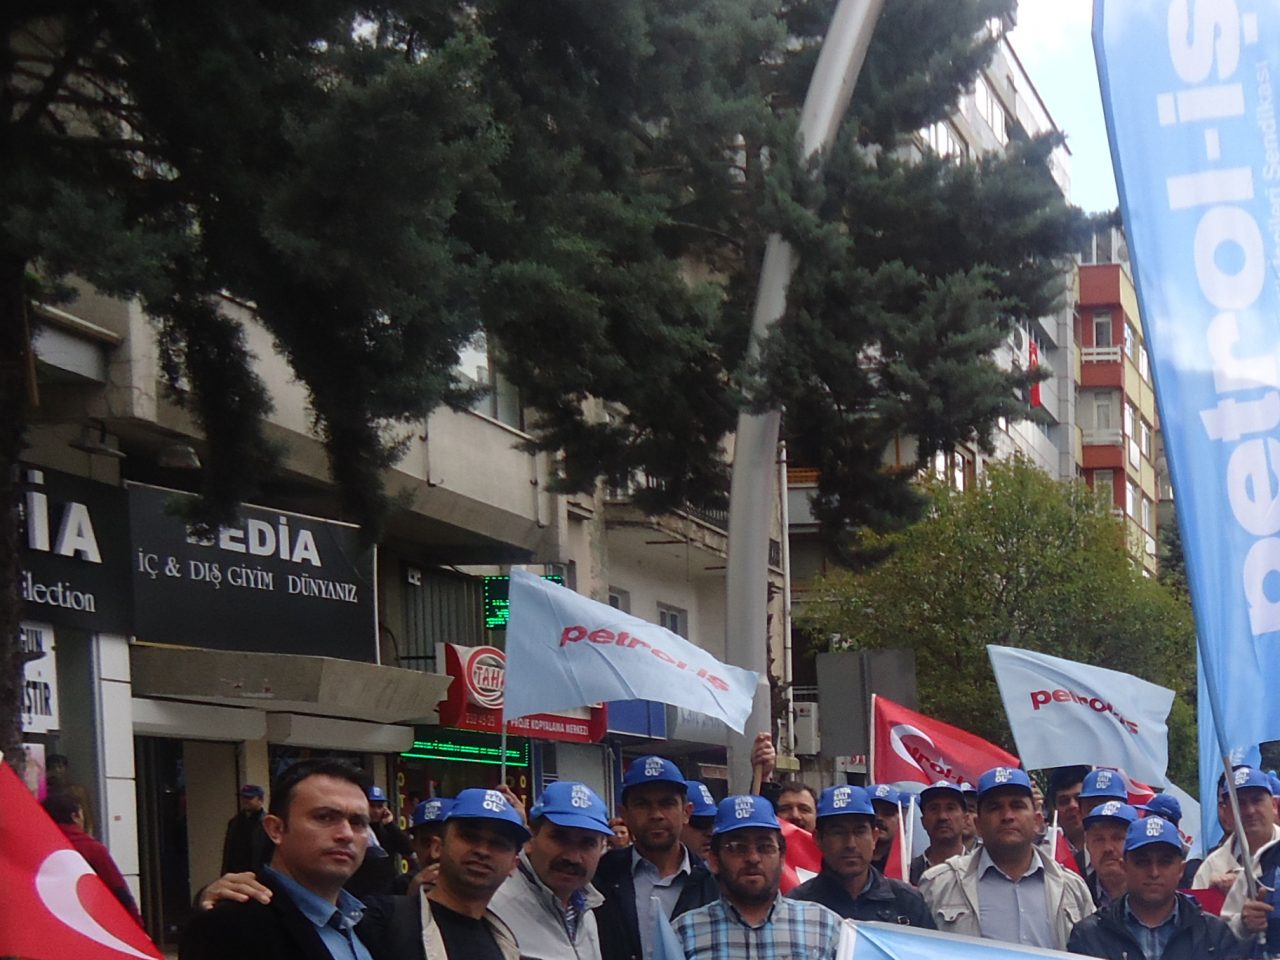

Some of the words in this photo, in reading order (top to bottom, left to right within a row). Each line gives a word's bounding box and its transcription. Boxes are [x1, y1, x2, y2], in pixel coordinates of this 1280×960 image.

[21, 469, 103, 564] İA
[187, 515, 321, 568] EDİA
[22, 571, 96, 612] lection
[138, 548, 158, 579] İÇ
[165, 557, 181, 577] &
[190, 560, 222, 588] DIŞ
[227, 564, 274, 591] GİYİM
[287, 573, 358, 603] DÜNYANIZ
